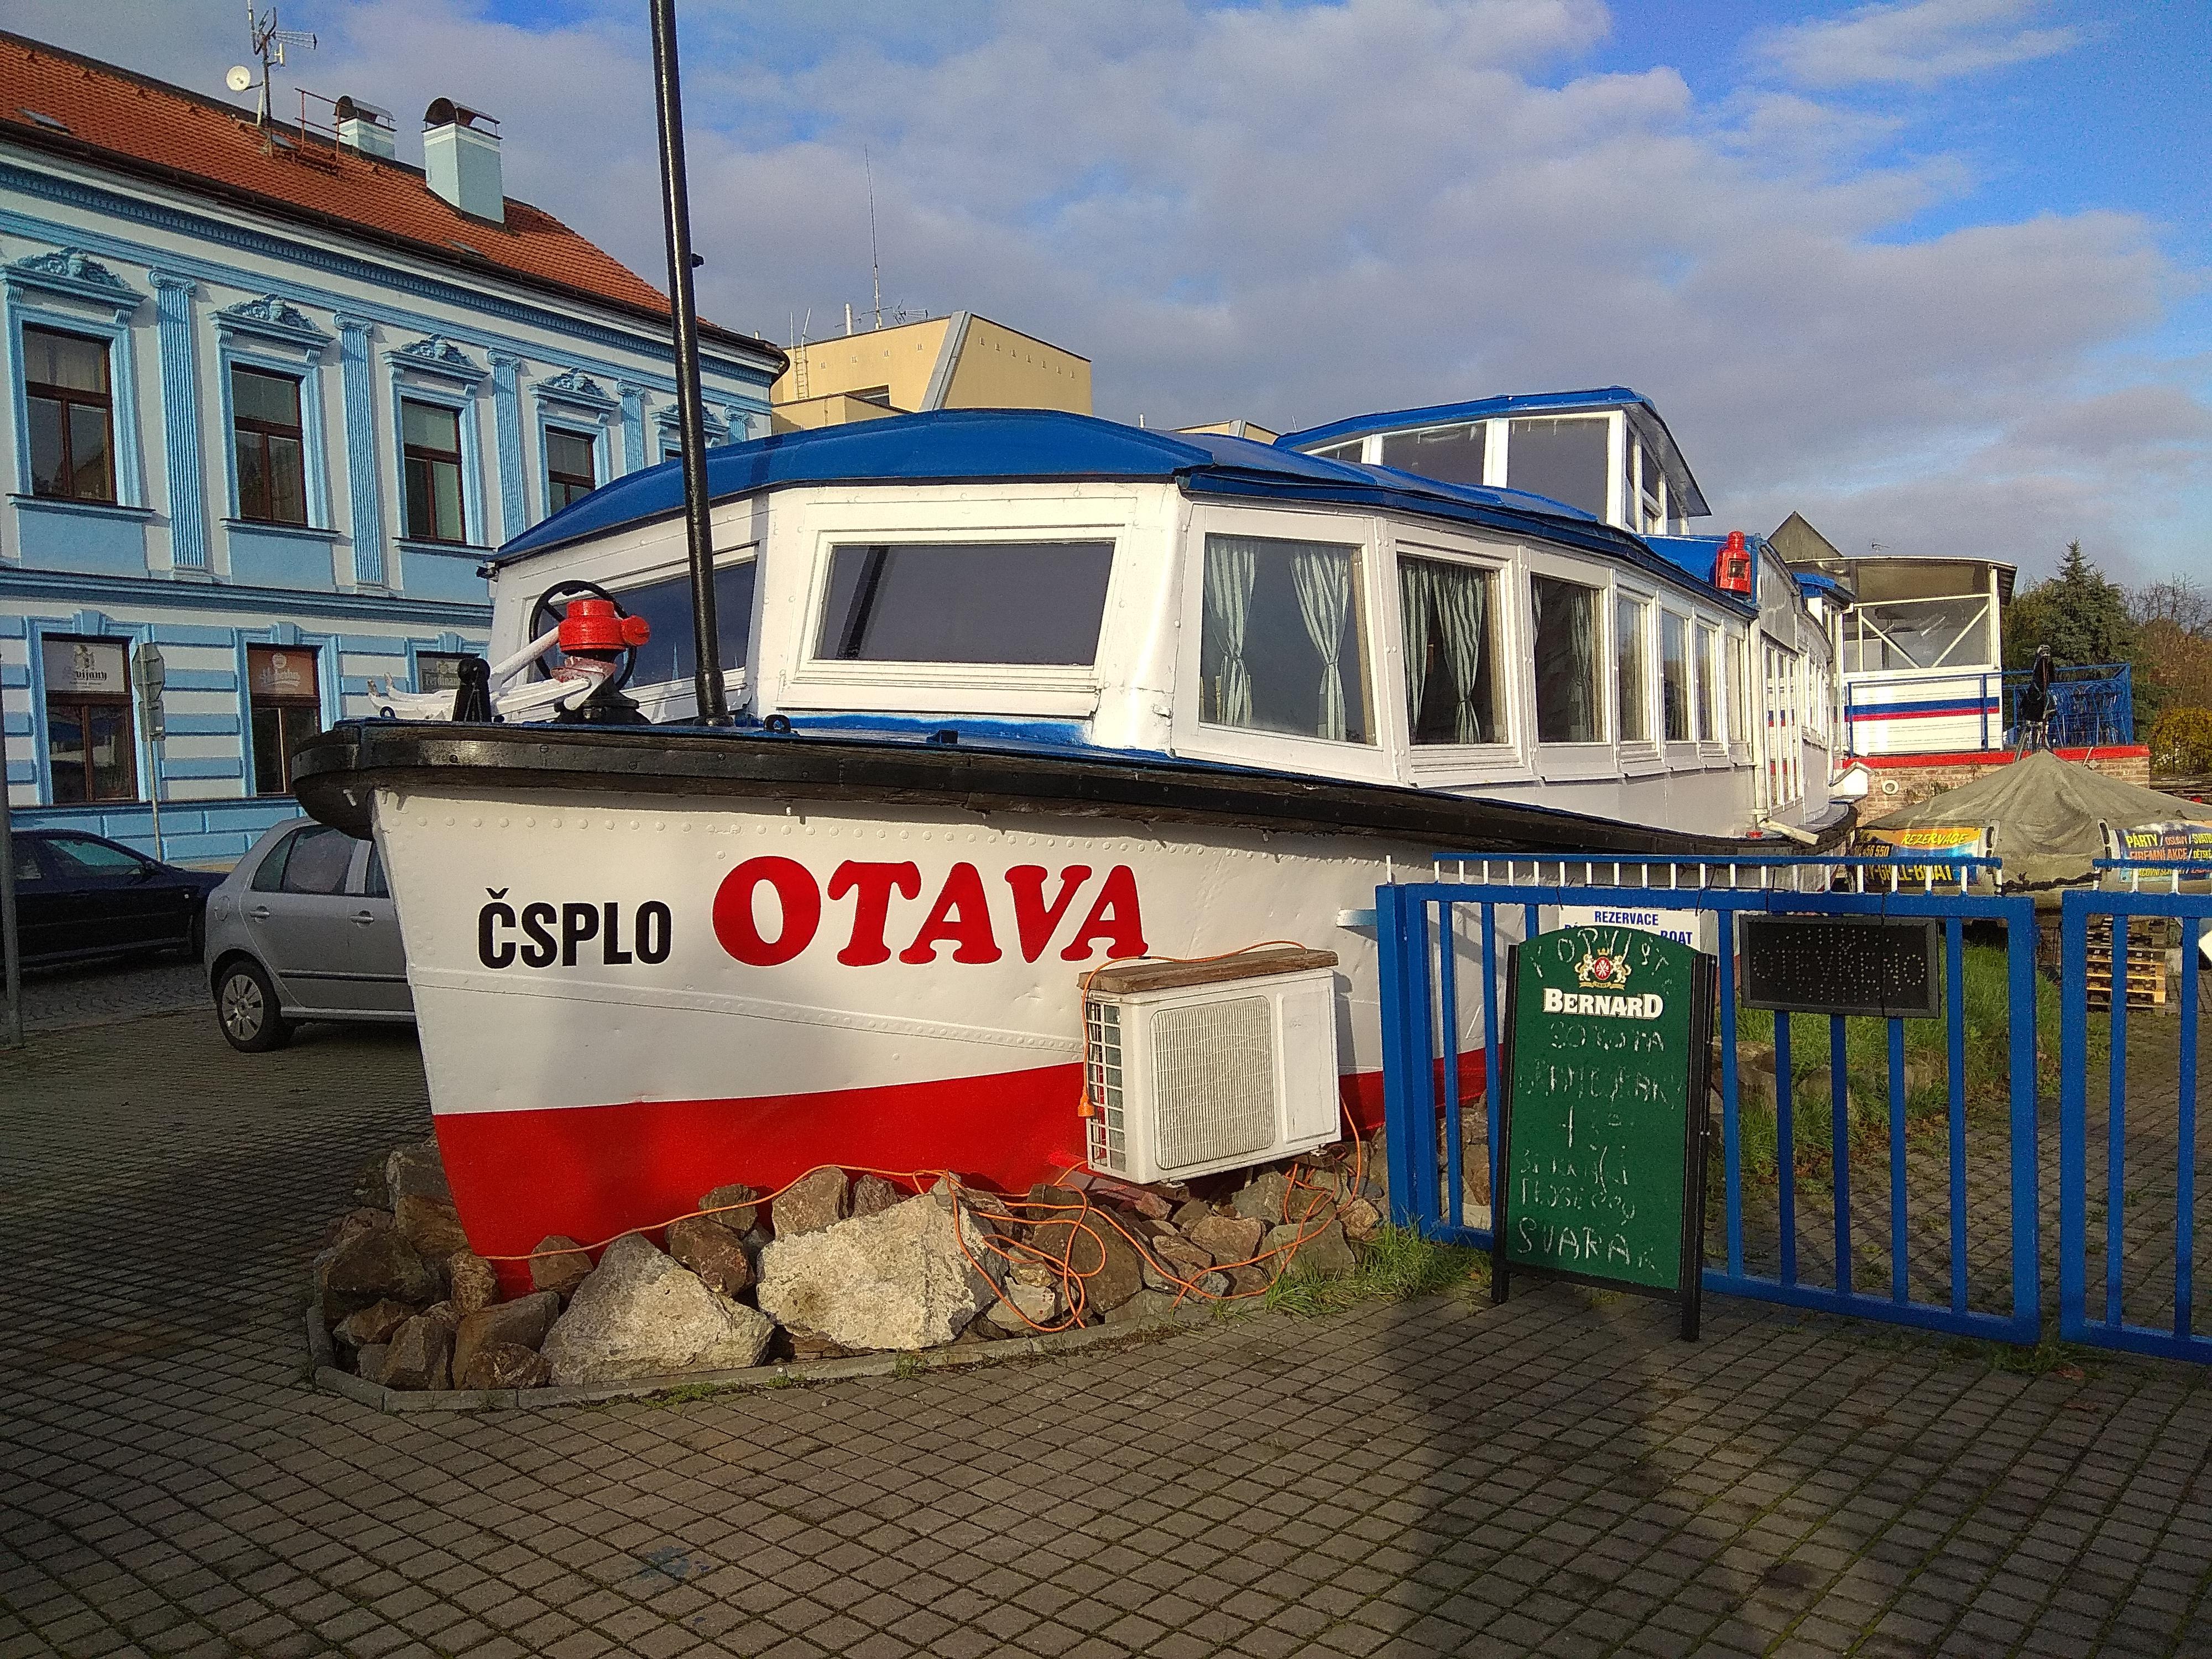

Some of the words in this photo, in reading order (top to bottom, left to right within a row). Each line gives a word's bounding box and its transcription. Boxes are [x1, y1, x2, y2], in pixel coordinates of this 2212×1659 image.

[425, 674, 461, 686] Ferdinan
[1901, 833, 1969, 846] REZERVACE
[2125, 833, 2158, 848] PÁRTY
[2167, 848, 2188, 860] AKCE
[478, 888, 671, 969] ČSPLO
[712, 855, 1149, 966] OTAVA
[1594, 911, 1659, 926] REZERVACE
[1543, 988, 1663, 1019] BERNARD
